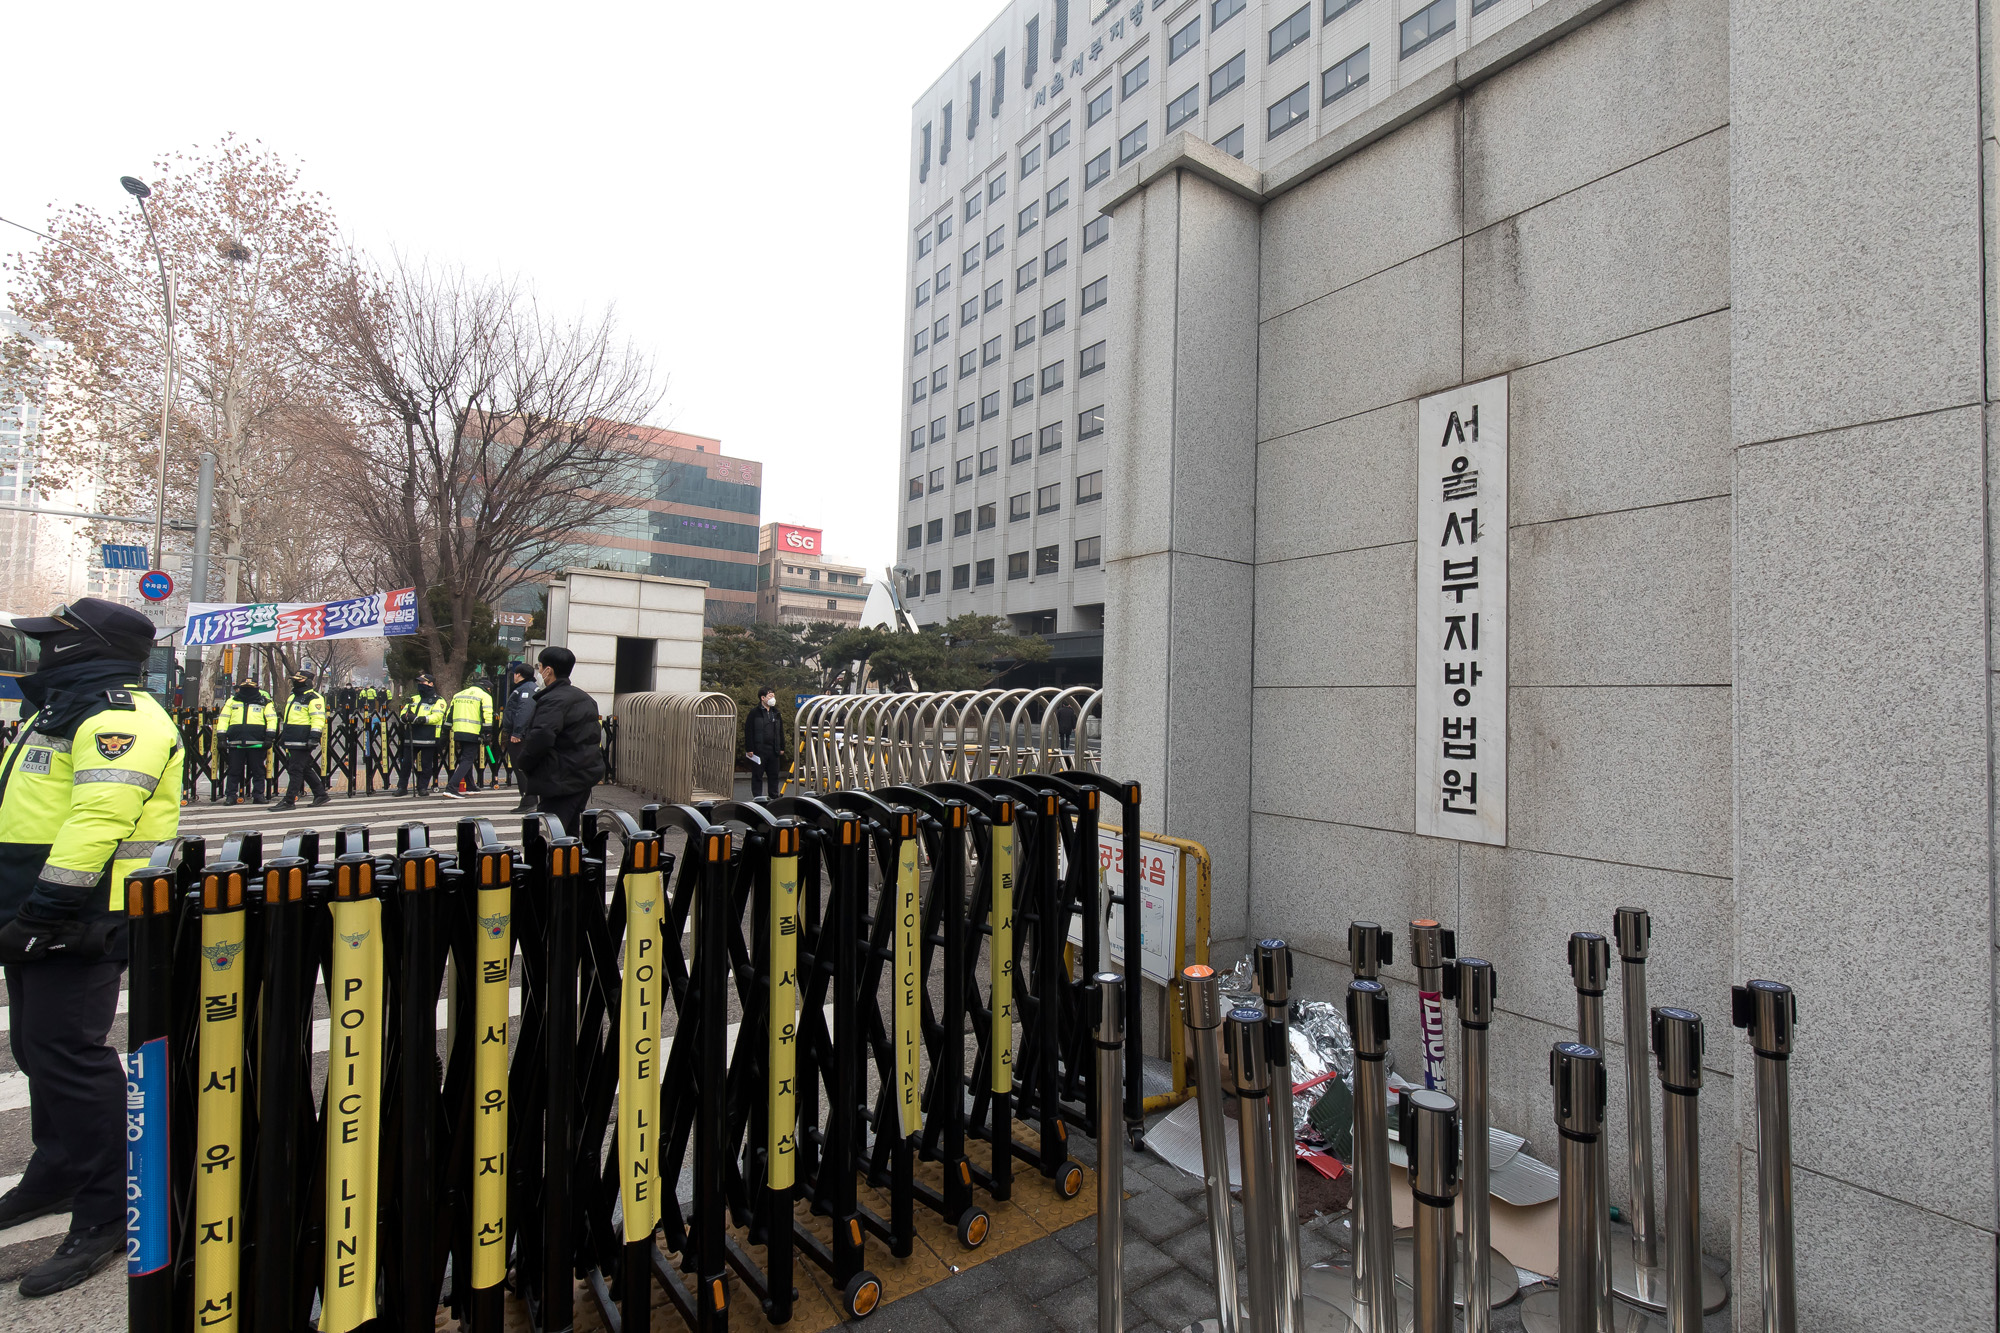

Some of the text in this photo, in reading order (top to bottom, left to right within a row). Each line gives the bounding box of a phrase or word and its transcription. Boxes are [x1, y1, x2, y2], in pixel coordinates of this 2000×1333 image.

[1034, 0, 1167, 110] 서울서부지방
[186, 603, 279, 646] 사기탄핵
[277, 610, 325, 642] 즉시
[385, 608, 415, 624] 통일당
[393, 591, 415, 607] 자유
[1441, 404, 1483, 816] 서울서부지방법원
[22, 763, 47, 772] POLICE
[477, 959, 508, 1247] 질서유지선
[634, 938, 653, 1202] POLICE LINE
[777, 915, 797, 1155] 질서유지선
[903, 892, 915, 1106] POLICE LINE
[199, 993, 238, 1327] 질서유지선
[337, 977, 365, 1288] POLICE LINE
